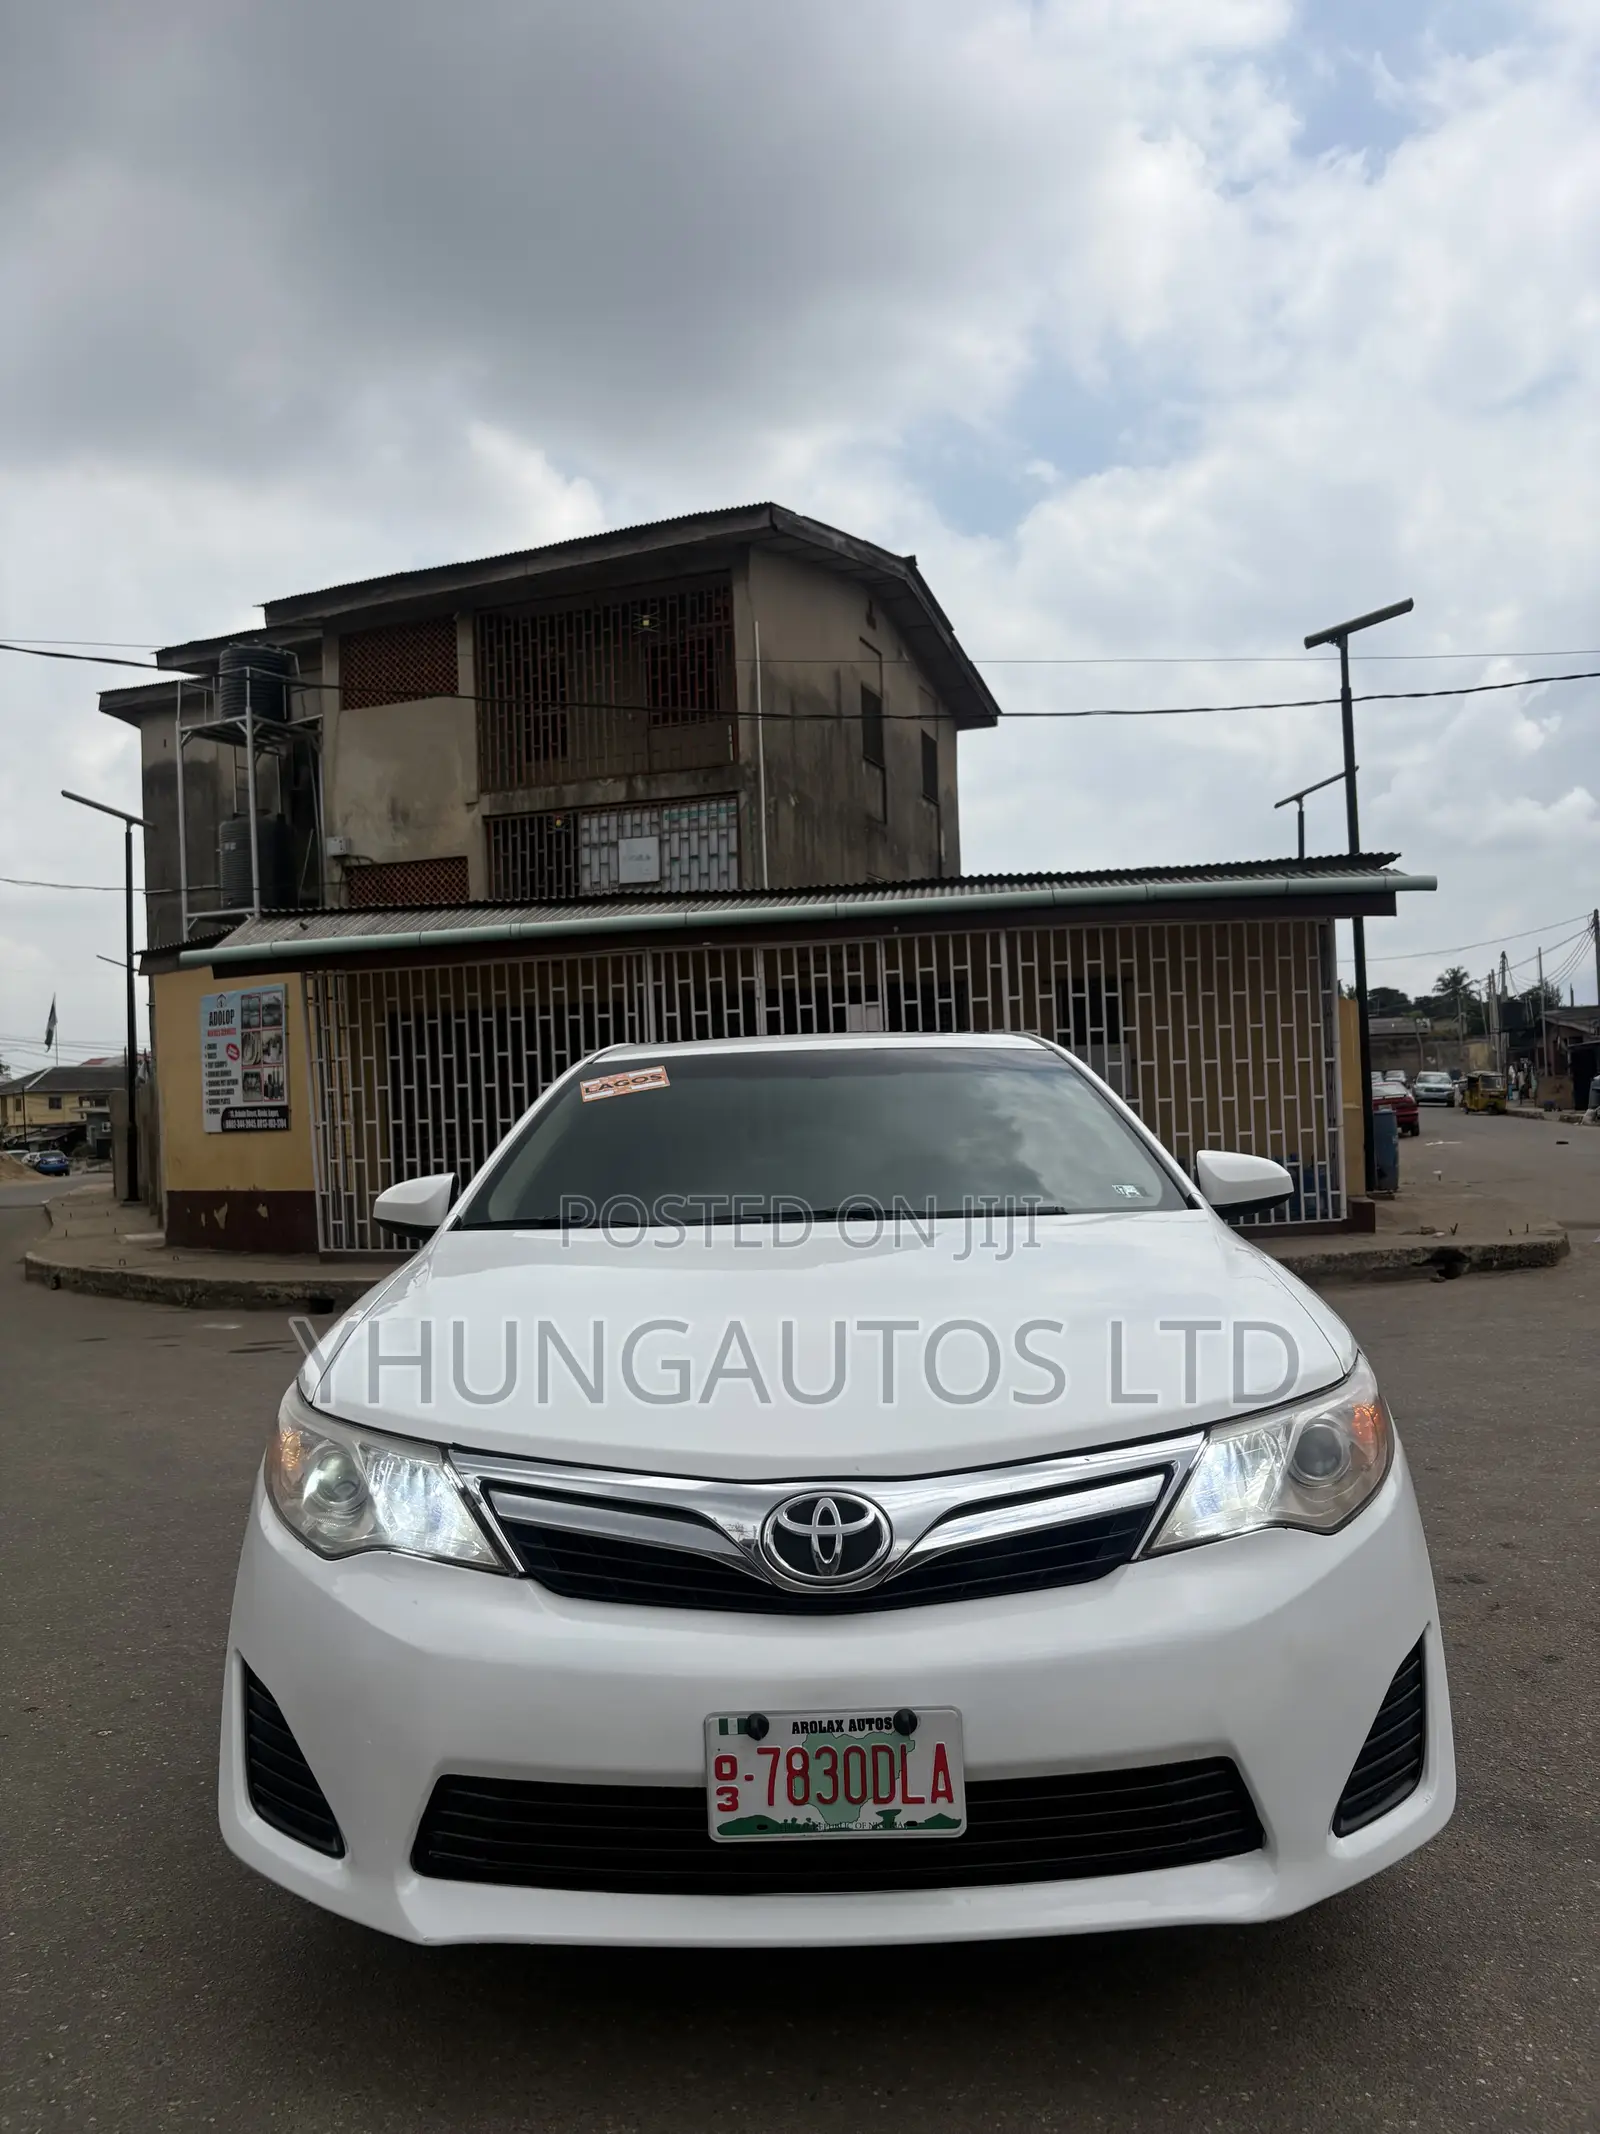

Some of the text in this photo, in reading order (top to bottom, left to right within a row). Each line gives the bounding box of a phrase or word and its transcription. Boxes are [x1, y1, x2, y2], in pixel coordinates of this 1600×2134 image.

[208, 1009, 235, 1026] ADOLOP
[584, 1074, 663, 1094] LAGOS
[791, 1717, 893, 1735] AROLAX AUTOS
